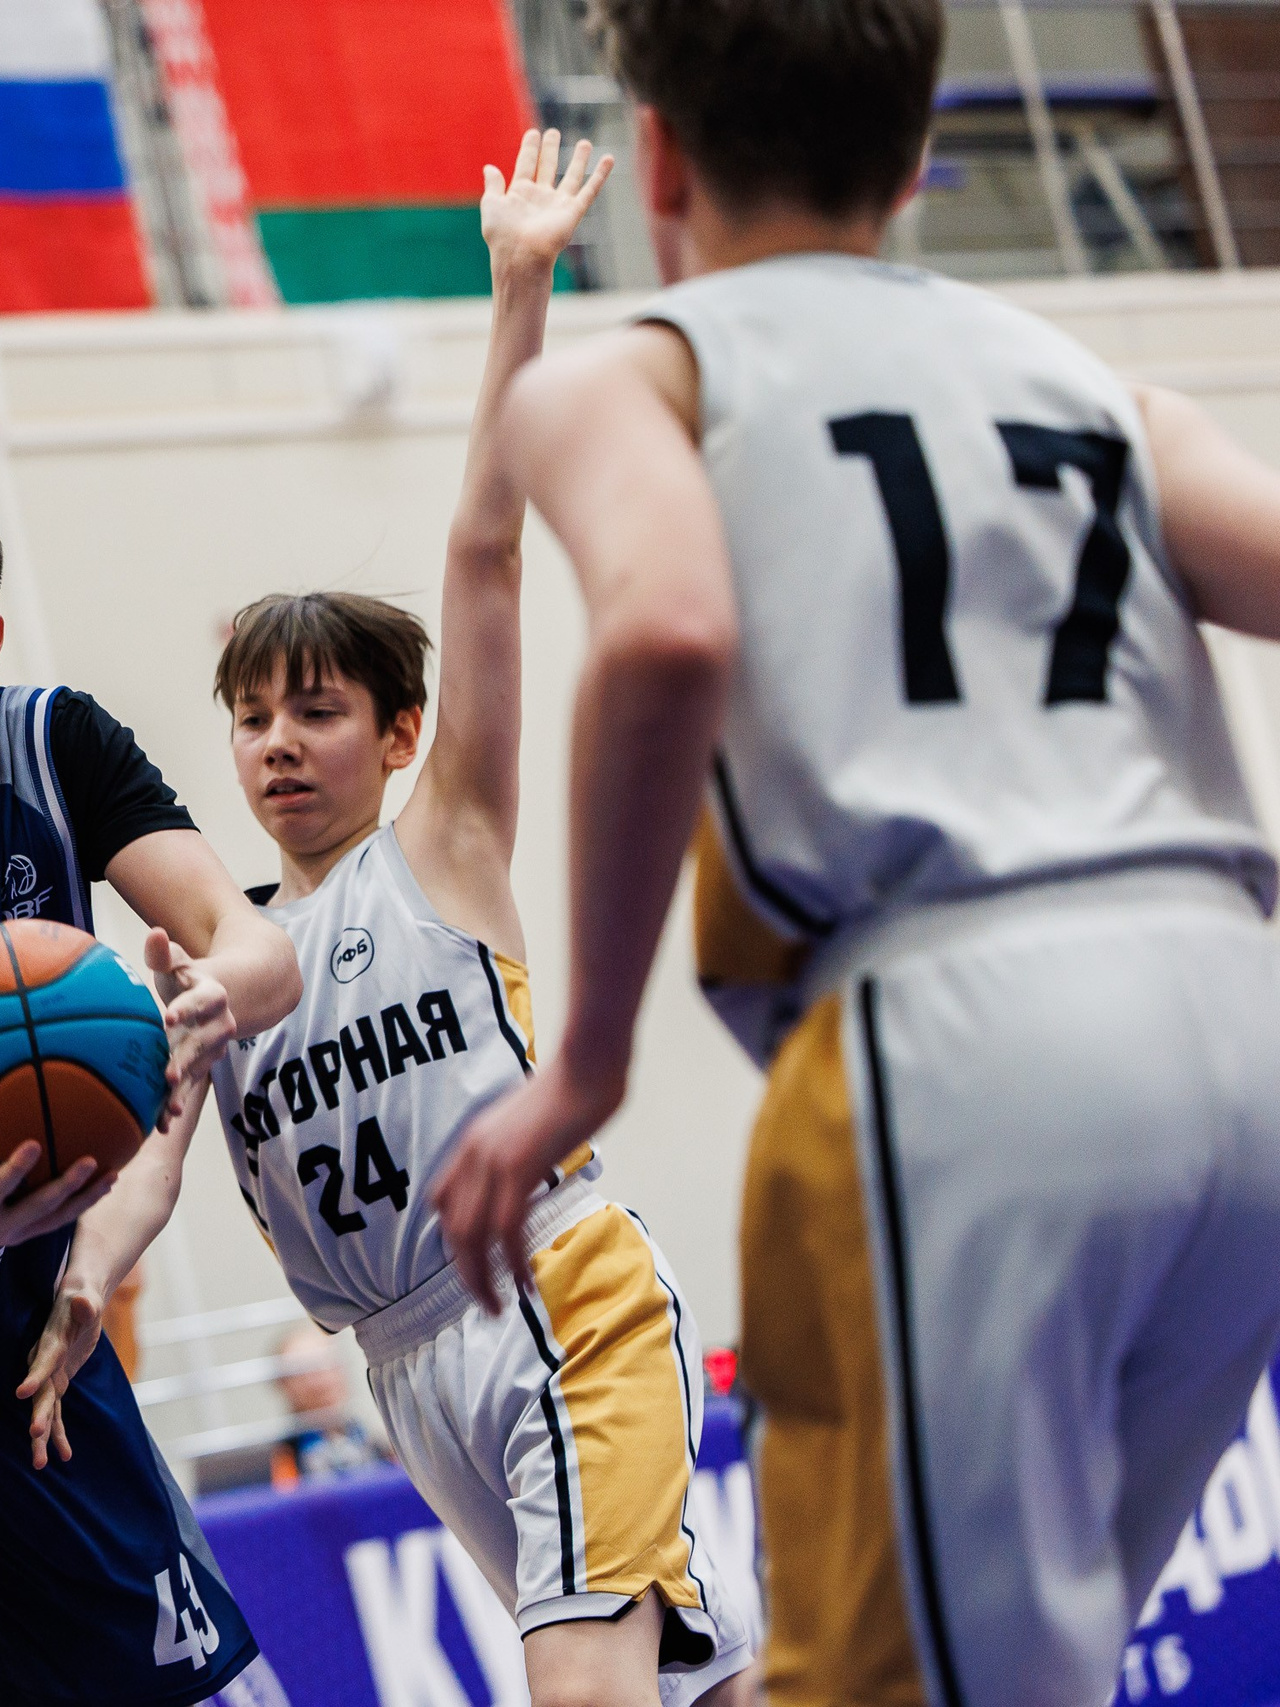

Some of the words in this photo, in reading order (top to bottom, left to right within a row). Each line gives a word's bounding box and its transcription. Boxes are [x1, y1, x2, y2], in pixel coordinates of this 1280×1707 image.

[827, 411, 1133, 709] 17
[2, 886, 53, 920] BF
[297, 1115, 411, 1237] 24
[153, 1552, 220, 1671] 43
